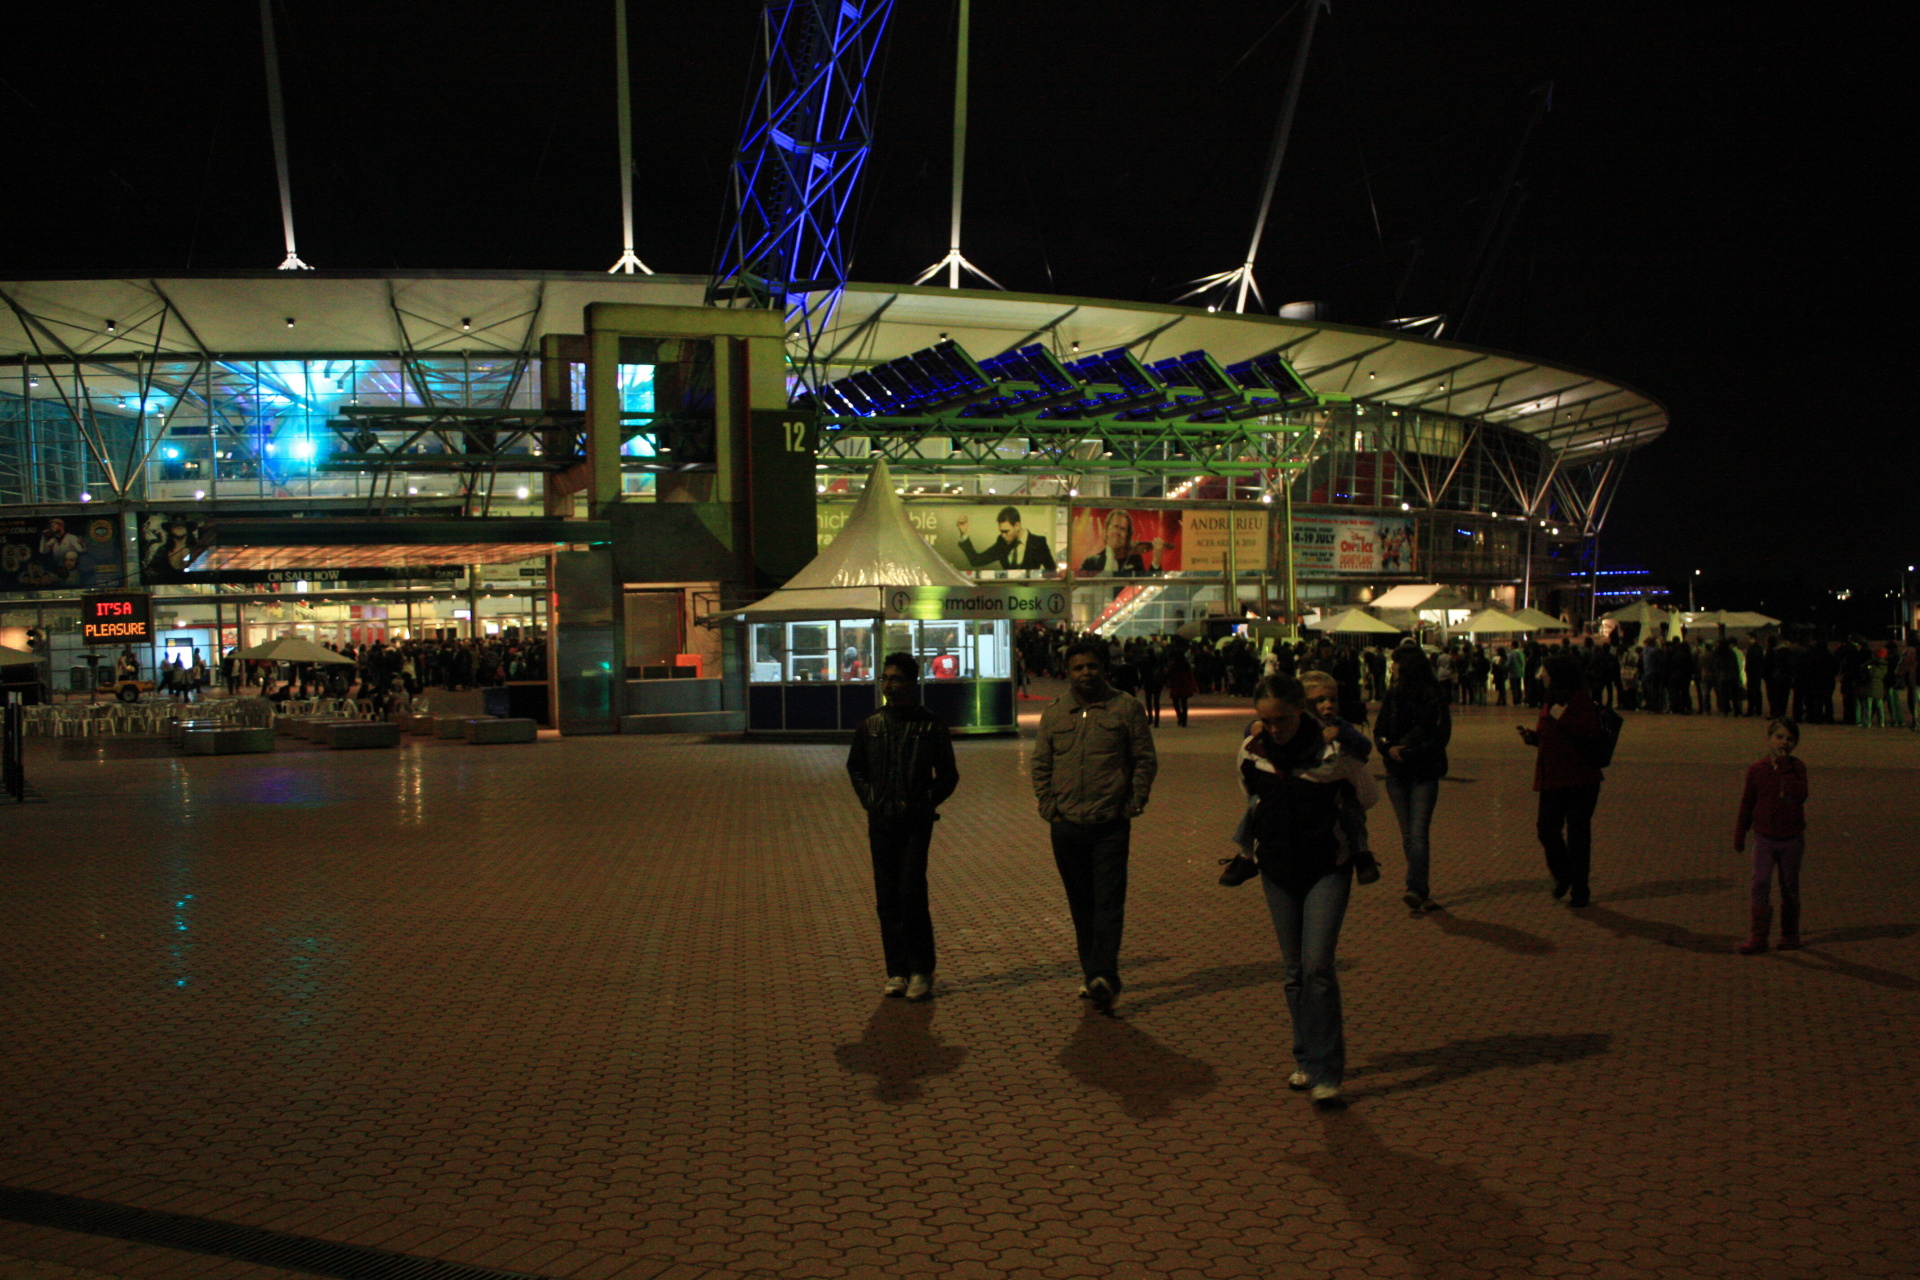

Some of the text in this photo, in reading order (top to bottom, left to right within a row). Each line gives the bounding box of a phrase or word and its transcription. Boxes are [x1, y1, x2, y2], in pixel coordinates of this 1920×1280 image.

[782, 421, 806, 452] 12
[1236, 517, 1263, 530] RIEU
[1315, 532, 1336, 545] JULY
[267, 570, 340, 582] ON SALE NOW
[96, 601, 133, 617] IT'S A
[1008, 596, 1043, 611] Desk
[85, 622, 147, 637] PLEASURE
